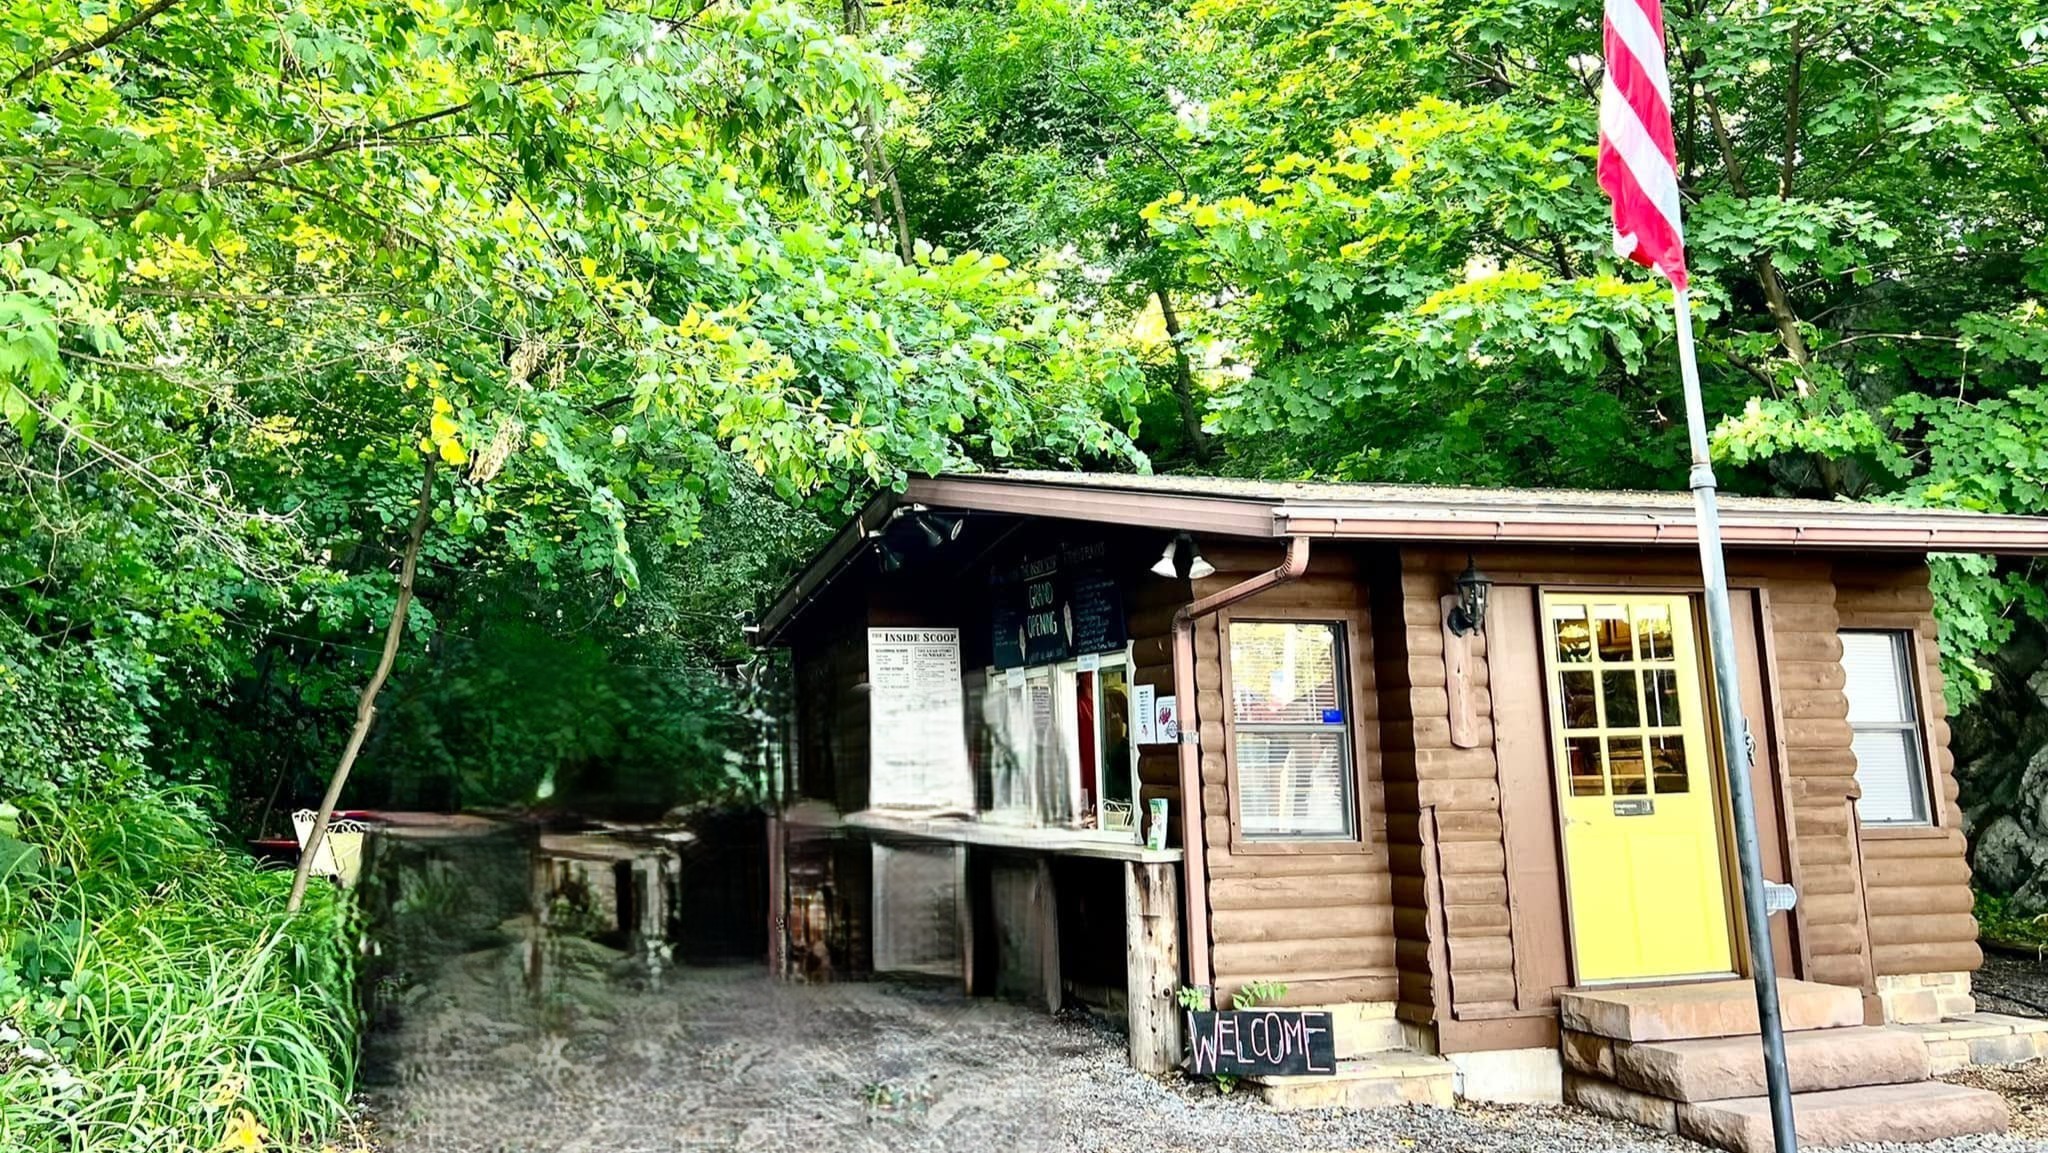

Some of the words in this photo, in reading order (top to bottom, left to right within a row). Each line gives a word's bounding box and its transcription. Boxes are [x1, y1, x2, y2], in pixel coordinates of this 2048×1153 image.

[1029, 582, 1053, 609] GRAND
[885, 633, 920, 642] INSIDE
[923, 633, 956, 642] SCOOP
[1027, 611, 1057, 639] OPENING
[1187, 1010, 1330, 1073] WELCOME
